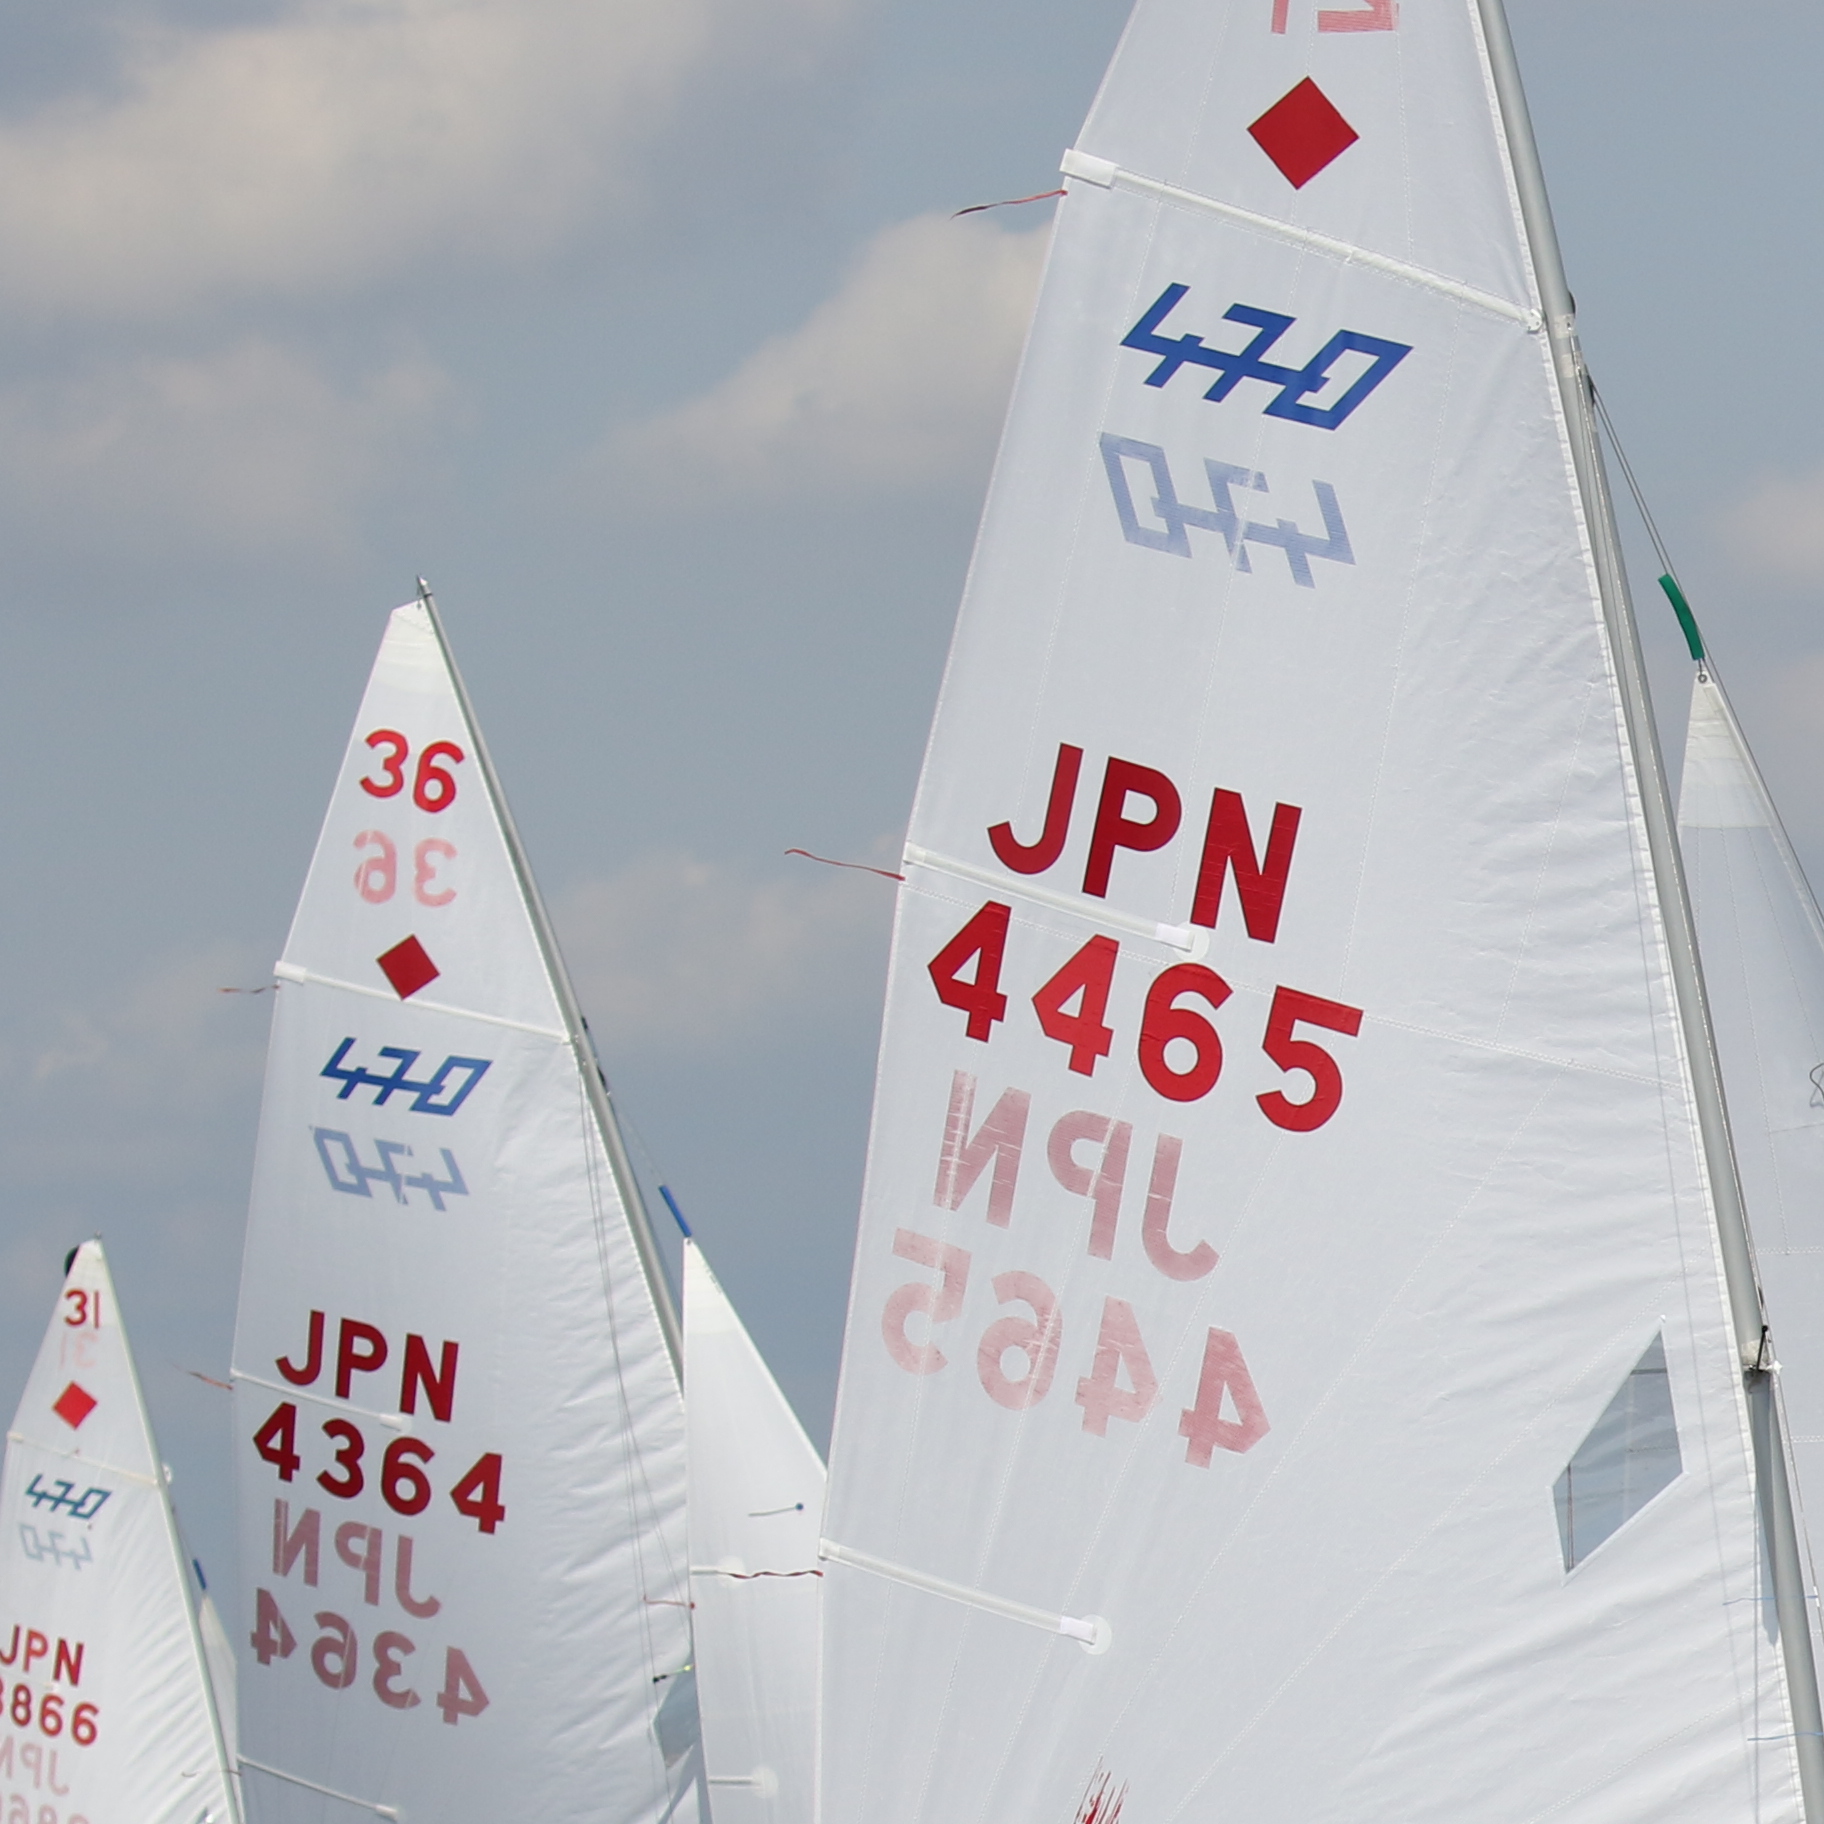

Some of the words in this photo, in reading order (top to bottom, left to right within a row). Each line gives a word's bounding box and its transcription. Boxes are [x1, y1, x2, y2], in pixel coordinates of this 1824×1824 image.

[1120, 283, 1414, 431] 470
[359, 729, 466, 812] 36
[987, 743, 1302, 943] JPN
[927, 900, 1365, 1133] 4465
[321, 1037, 493, 1117] 470
[64, 1288, 101, 1329] 31
[276, 1310, 459, 1422] JPN
[25, 1473, 111, 1520] 470
[253, 1401, 506, 1535] 4364
[0, 1624, 84, 1687] JPN
[0, 1675, 99, 1747] 866
